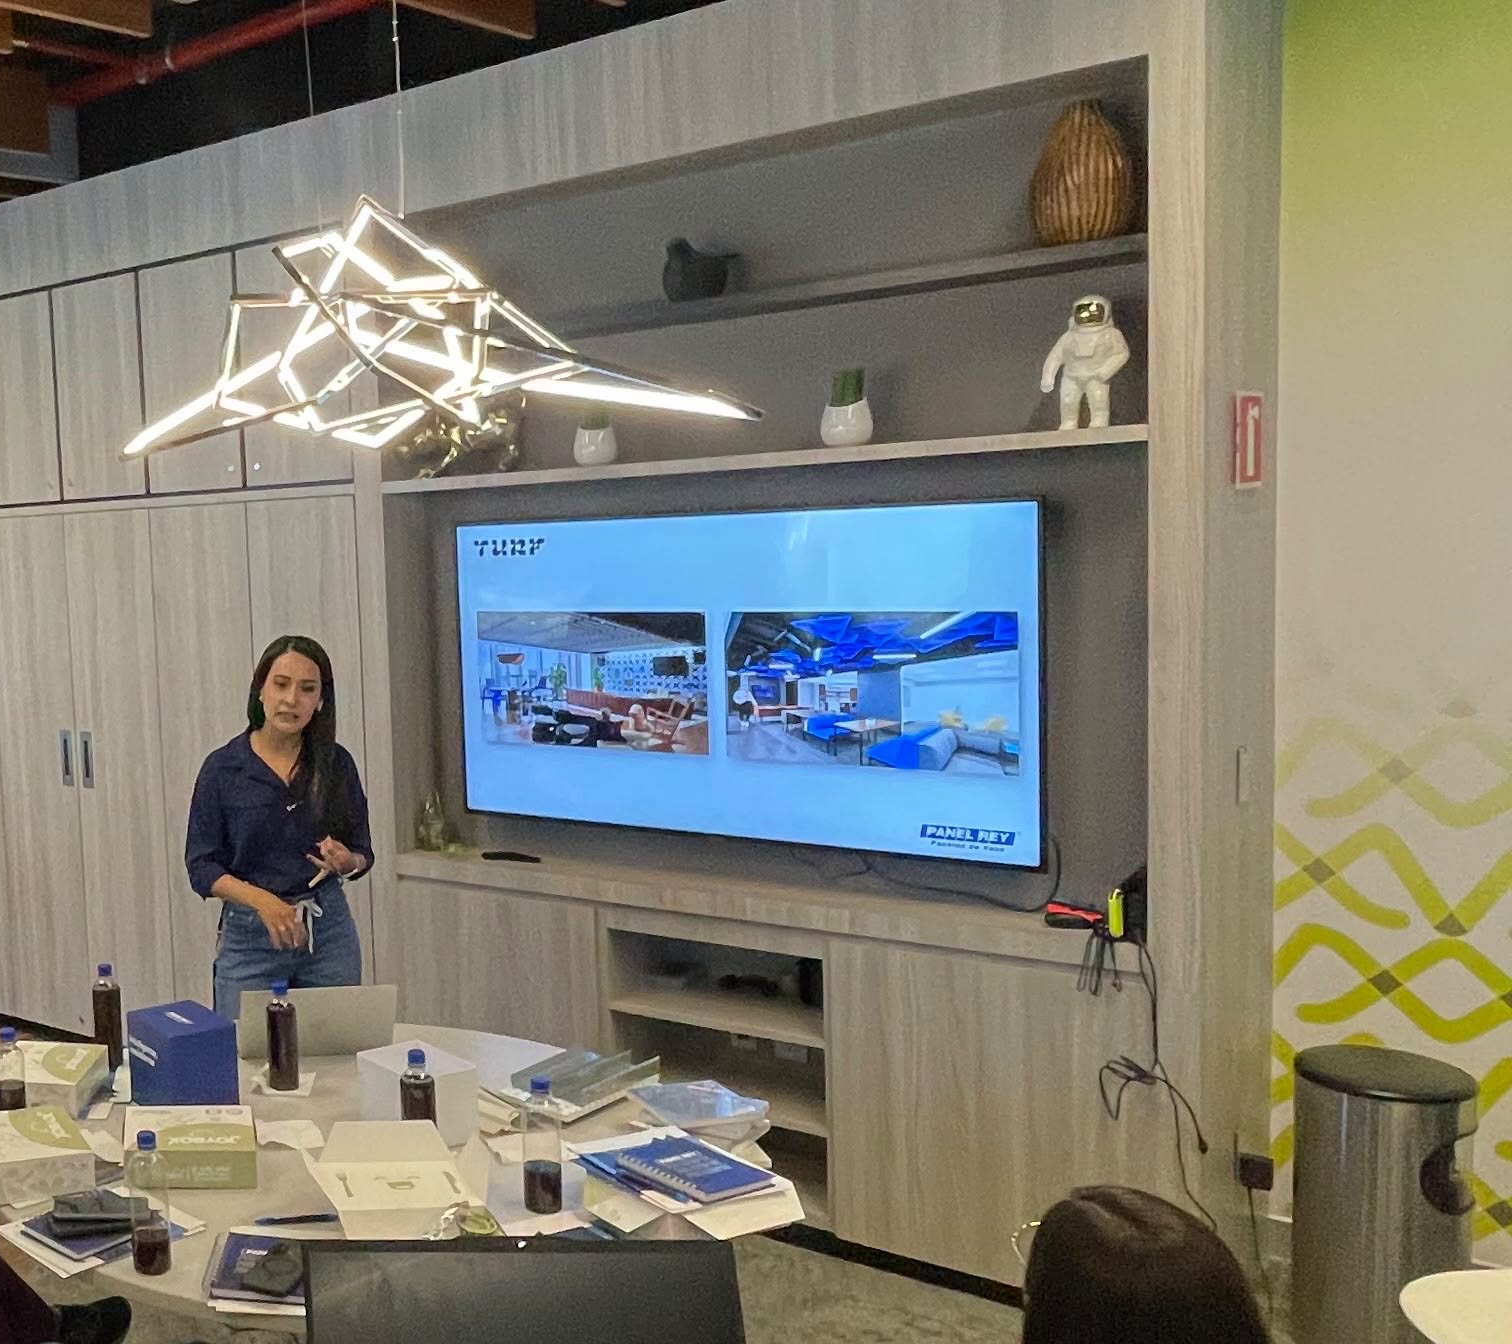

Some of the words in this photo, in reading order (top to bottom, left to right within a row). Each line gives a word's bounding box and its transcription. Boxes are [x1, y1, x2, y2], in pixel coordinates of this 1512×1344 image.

[474, 538, 544, 557] TURF
[925, 826, 975, 841] PANEL
[978, 830, 1010, 843] REY
